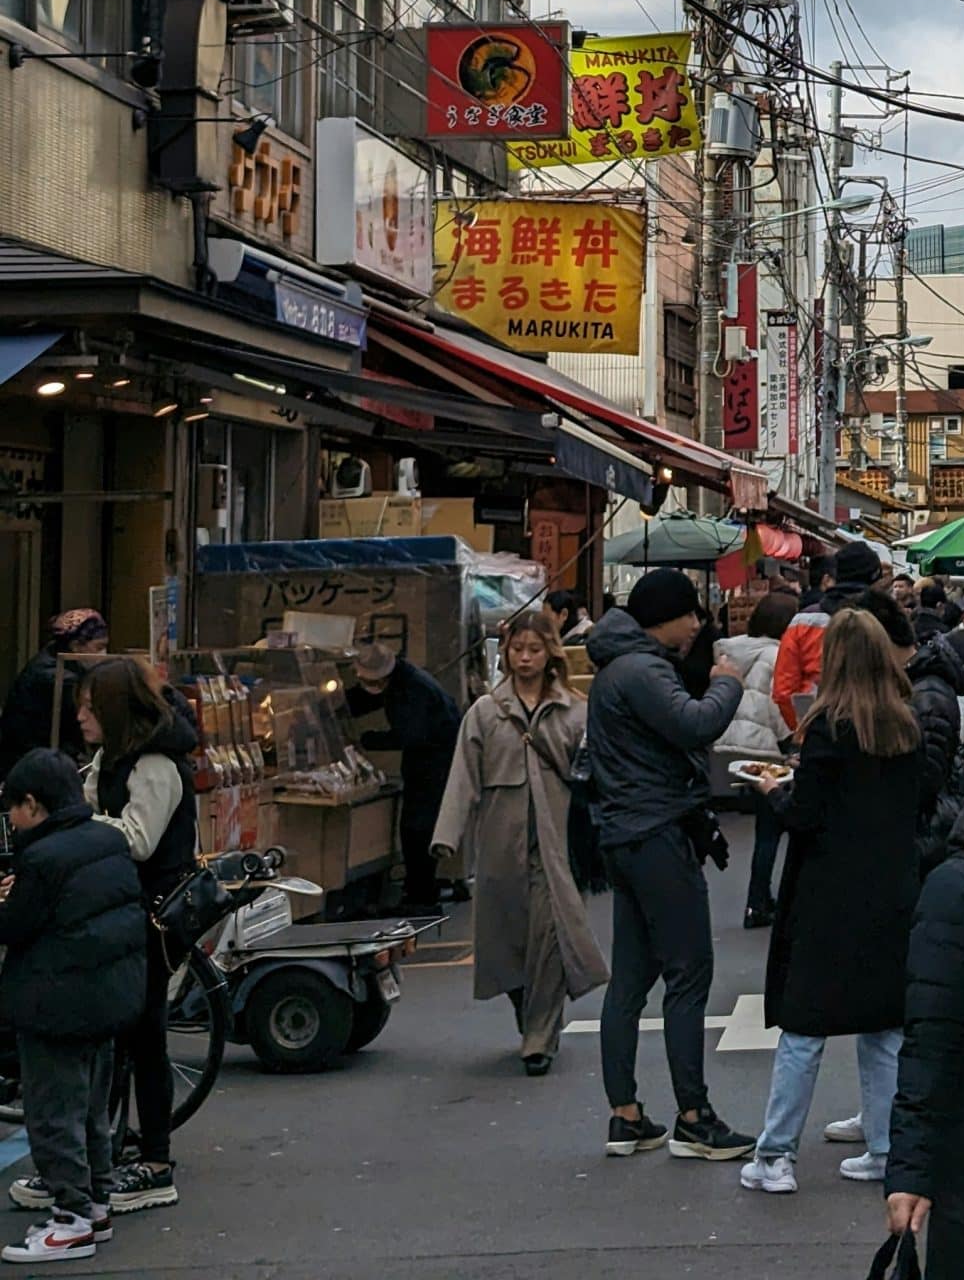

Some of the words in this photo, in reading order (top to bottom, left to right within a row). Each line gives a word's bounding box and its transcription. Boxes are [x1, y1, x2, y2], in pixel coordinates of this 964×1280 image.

[585, 46, 679, 69] MARUKITA
[514, 142, 577, 161] TSUKIJI
[589, 125, 692, 158] まるきた
[451, 216, 618, 269] 海鮮丼
[452, 276, 617, 314] まるきた
[508, 320, 614, 340] MARUKITA
[263, 575, 395, 607] パッケージ
